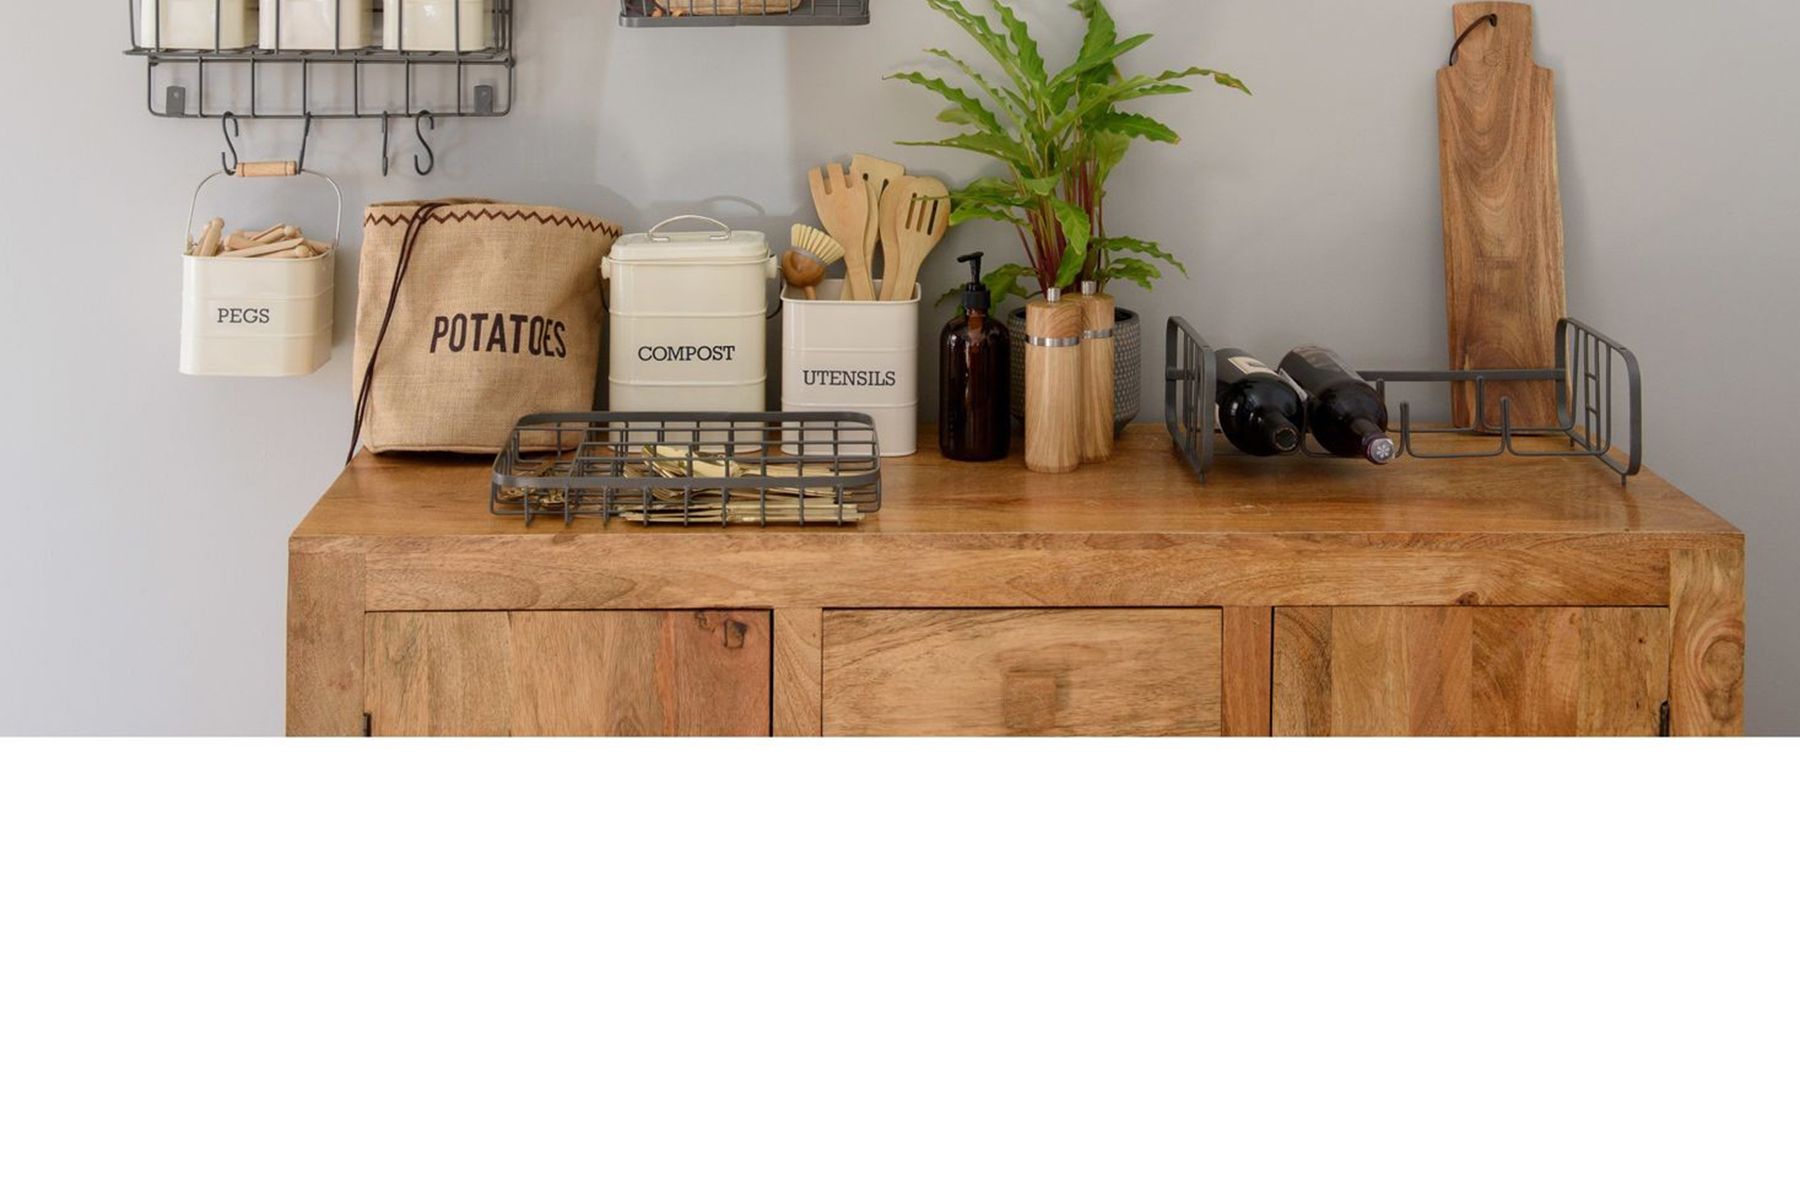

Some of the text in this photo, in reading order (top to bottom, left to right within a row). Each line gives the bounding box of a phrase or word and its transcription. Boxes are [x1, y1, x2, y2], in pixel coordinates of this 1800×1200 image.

[217, 307, 270, 324] PEGS
[430, 313, 567, 358] POTATOES
[638, 345, 736, 361] COMPOST
[803, 369, 896, 386] UTENSILS
